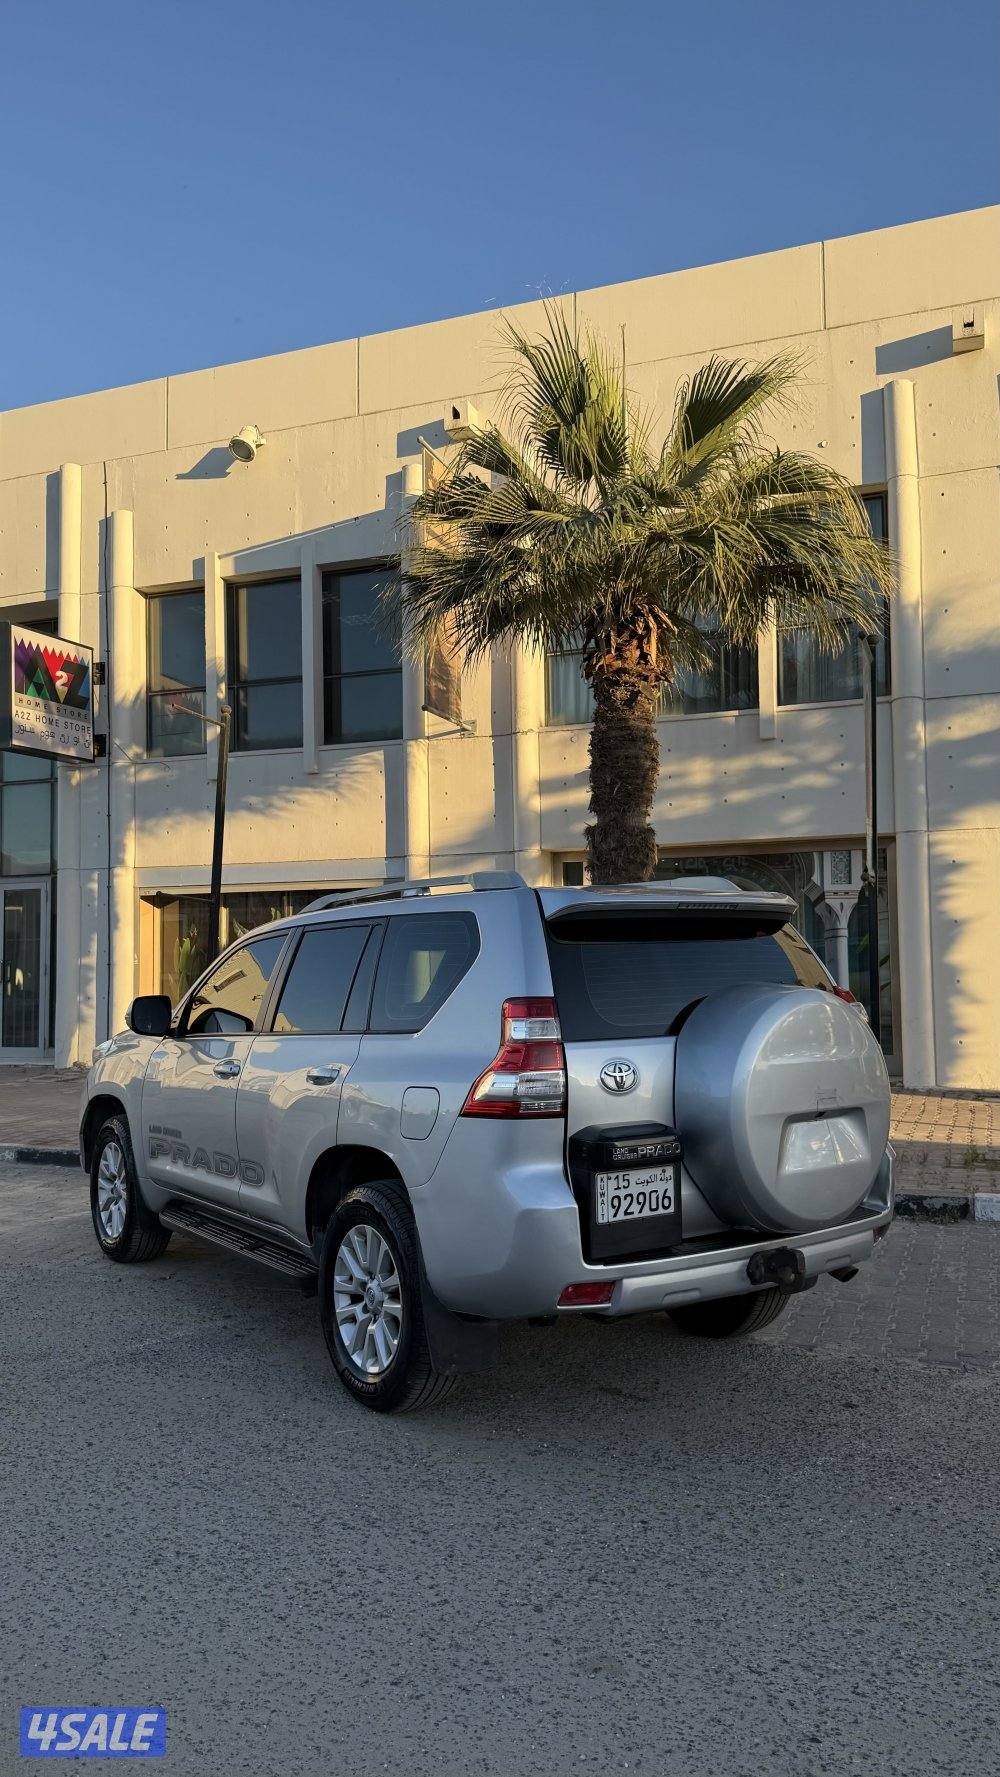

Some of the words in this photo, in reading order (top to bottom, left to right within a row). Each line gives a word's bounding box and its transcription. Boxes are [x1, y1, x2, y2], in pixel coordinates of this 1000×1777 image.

[18, 697, 48, 710] HOME
[56, 706, 88, 720] STORE
[14, 710, 31, 721] A2Z
[35, 714, 60, 728] HOME
[63, 721, 91, 735] STORE
[14, 723, 36, 735] ستور
[637, 1142, 681, 1159] PRADO
[148, 1137, 266, 1188] PRADO
[613, 1173, 631, 1191] 15
[635, 1172, 658, 1187] الكويت
[659, 1172, 672, 1184] دولة
[610, 1188, 672, 1219] 92906
